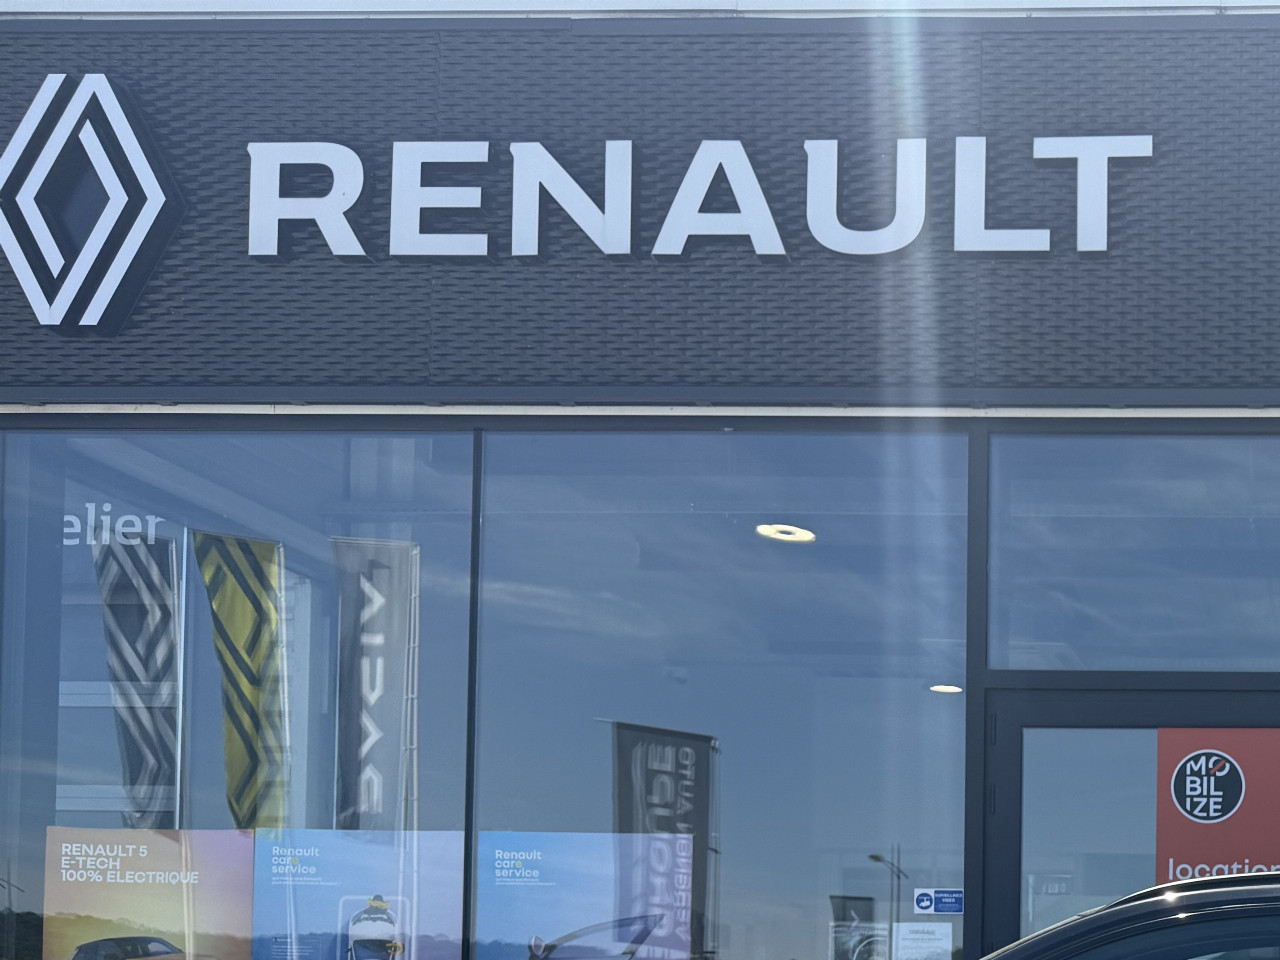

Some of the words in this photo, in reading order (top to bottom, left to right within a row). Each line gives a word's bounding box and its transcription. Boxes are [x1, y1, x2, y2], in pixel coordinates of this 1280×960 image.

[247, 135, 1153, 256] RENAULT
[61, 843, 136, 857] RENAULT
[139, 845, 148, 857] 5
[272, 846, 320, 856] Renault
[495, 850, 542, 860] Renault
[61, 857, 120, 869] E-TECH
[495, 859, 523, 868] care
[272, 864, 317, 874] service
[495, 867, 539, 878] service
[61, 869, 103, 882] 100%
